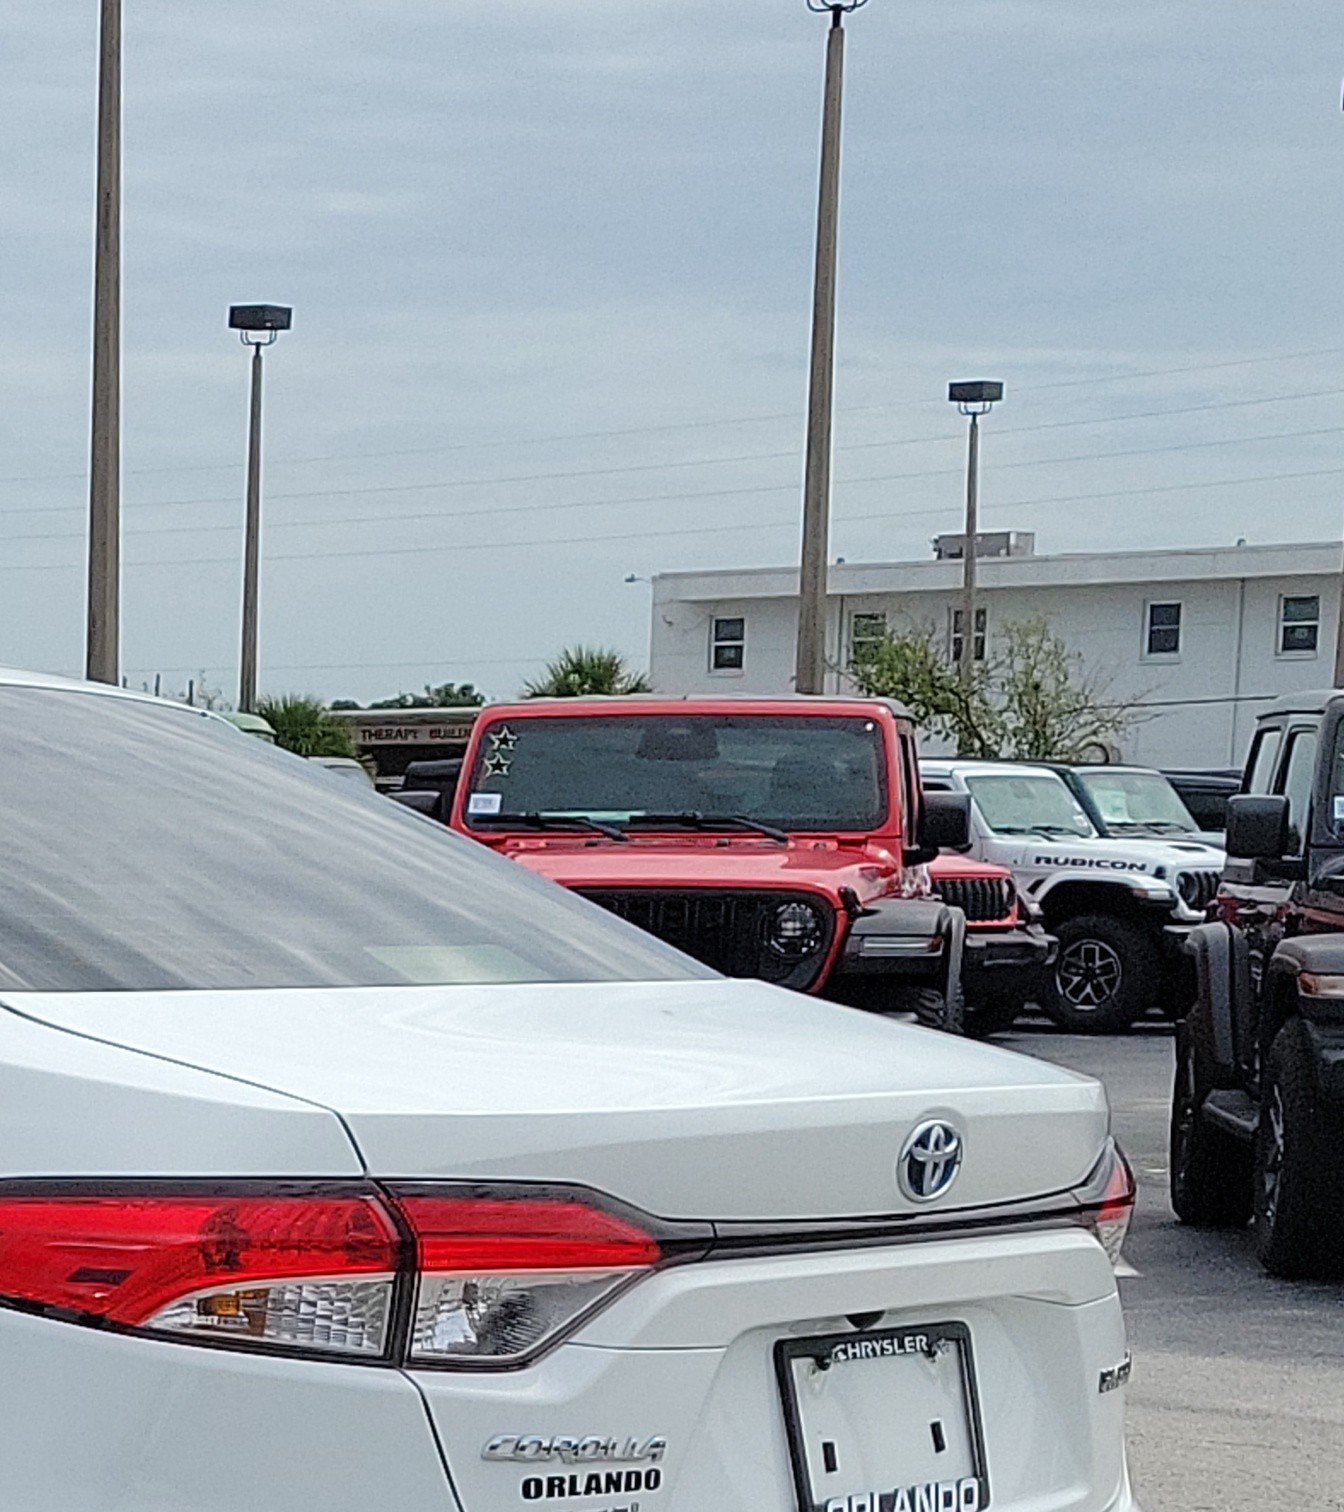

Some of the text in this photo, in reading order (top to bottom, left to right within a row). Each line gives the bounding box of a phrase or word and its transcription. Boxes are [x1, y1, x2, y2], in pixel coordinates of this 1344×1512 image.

[361, 728, 418, 741] THERAPY
[1034, 856, 1147, 871] RUBICON
[832, 1334, 929, 1361] CHRYSLER
[480, 1432, 667, 1464] COROLLA
[521, 1468, 662, 1500] ORLANDO
